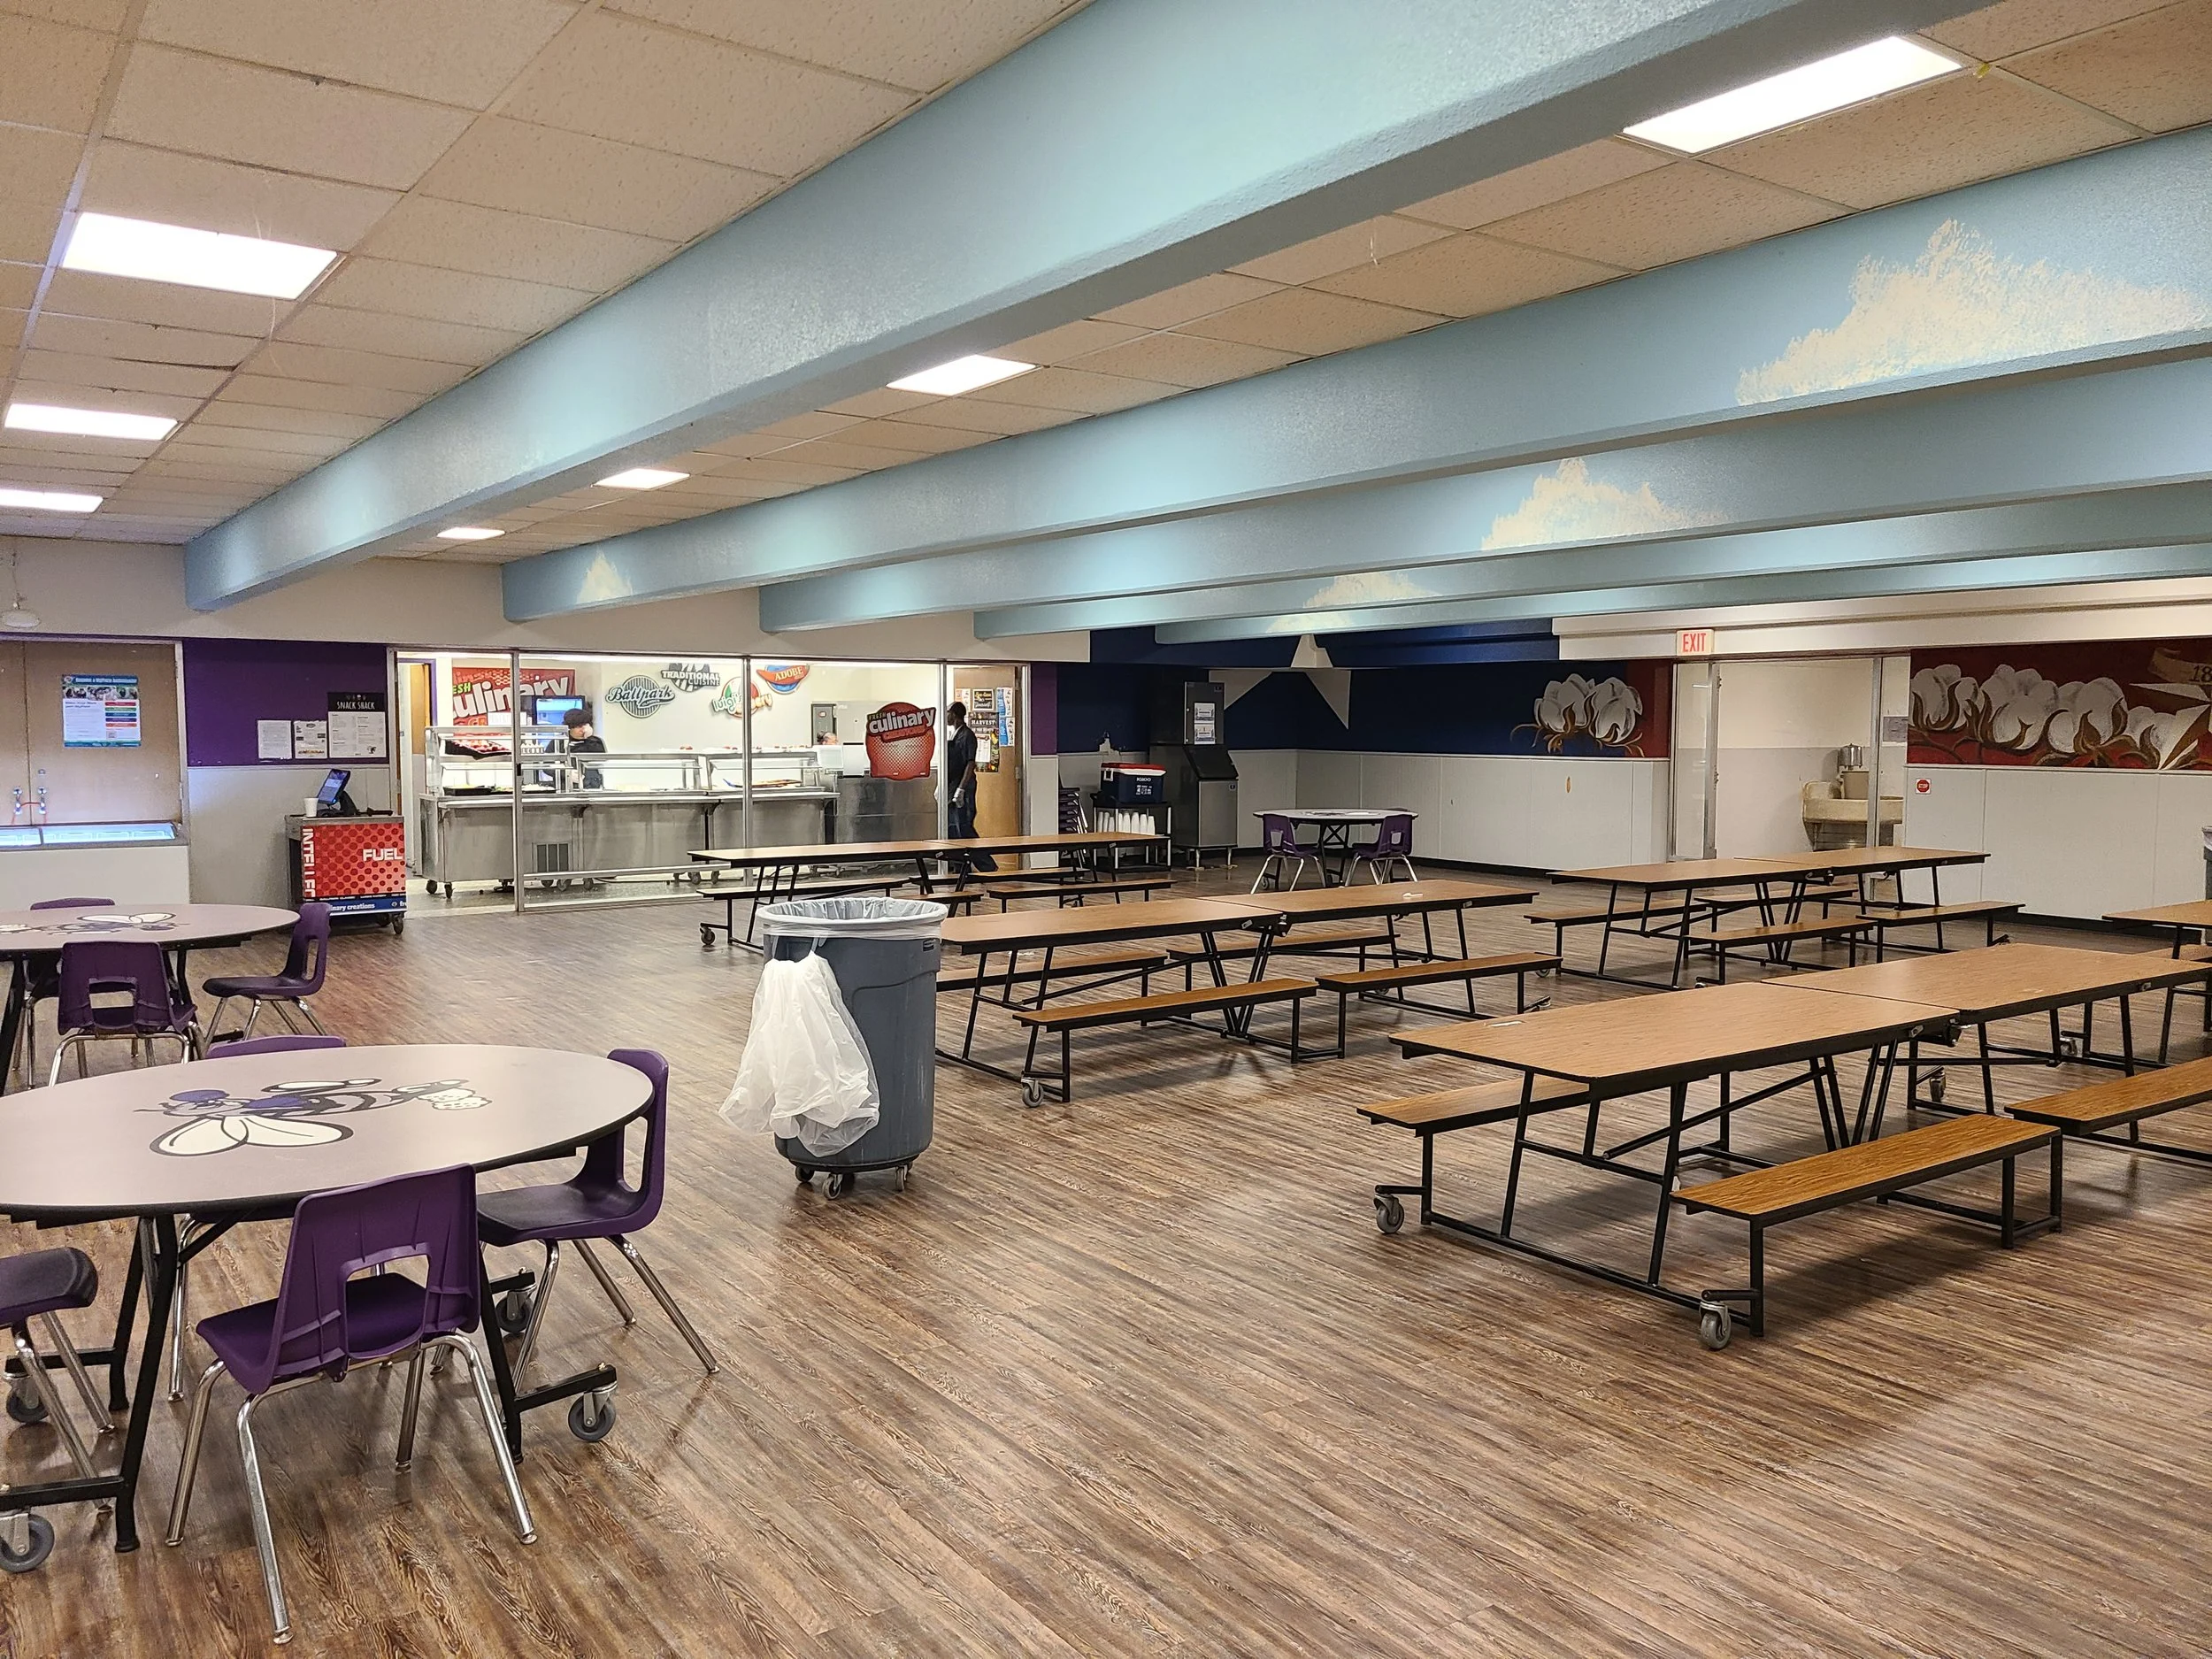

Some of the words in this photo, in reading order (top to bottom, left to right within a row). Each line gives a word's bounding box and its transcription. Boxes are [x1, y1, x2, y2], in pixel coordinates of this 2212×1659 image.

[1683, 633, 1707, 652] EXIT
[661, 671, 719, 680] TRADITIONAL
[775, 666, 803, 681] ADOBE
[2188, 665, 2212, 682] 18
[607, 686, 672, 704] Ballpark
[337, 701, 356, 710] SNACK
[357, 701, 375, 710] SHACK
[869, 709, 934, 733] culinary
[363, 848, 403, 862] FUEL
